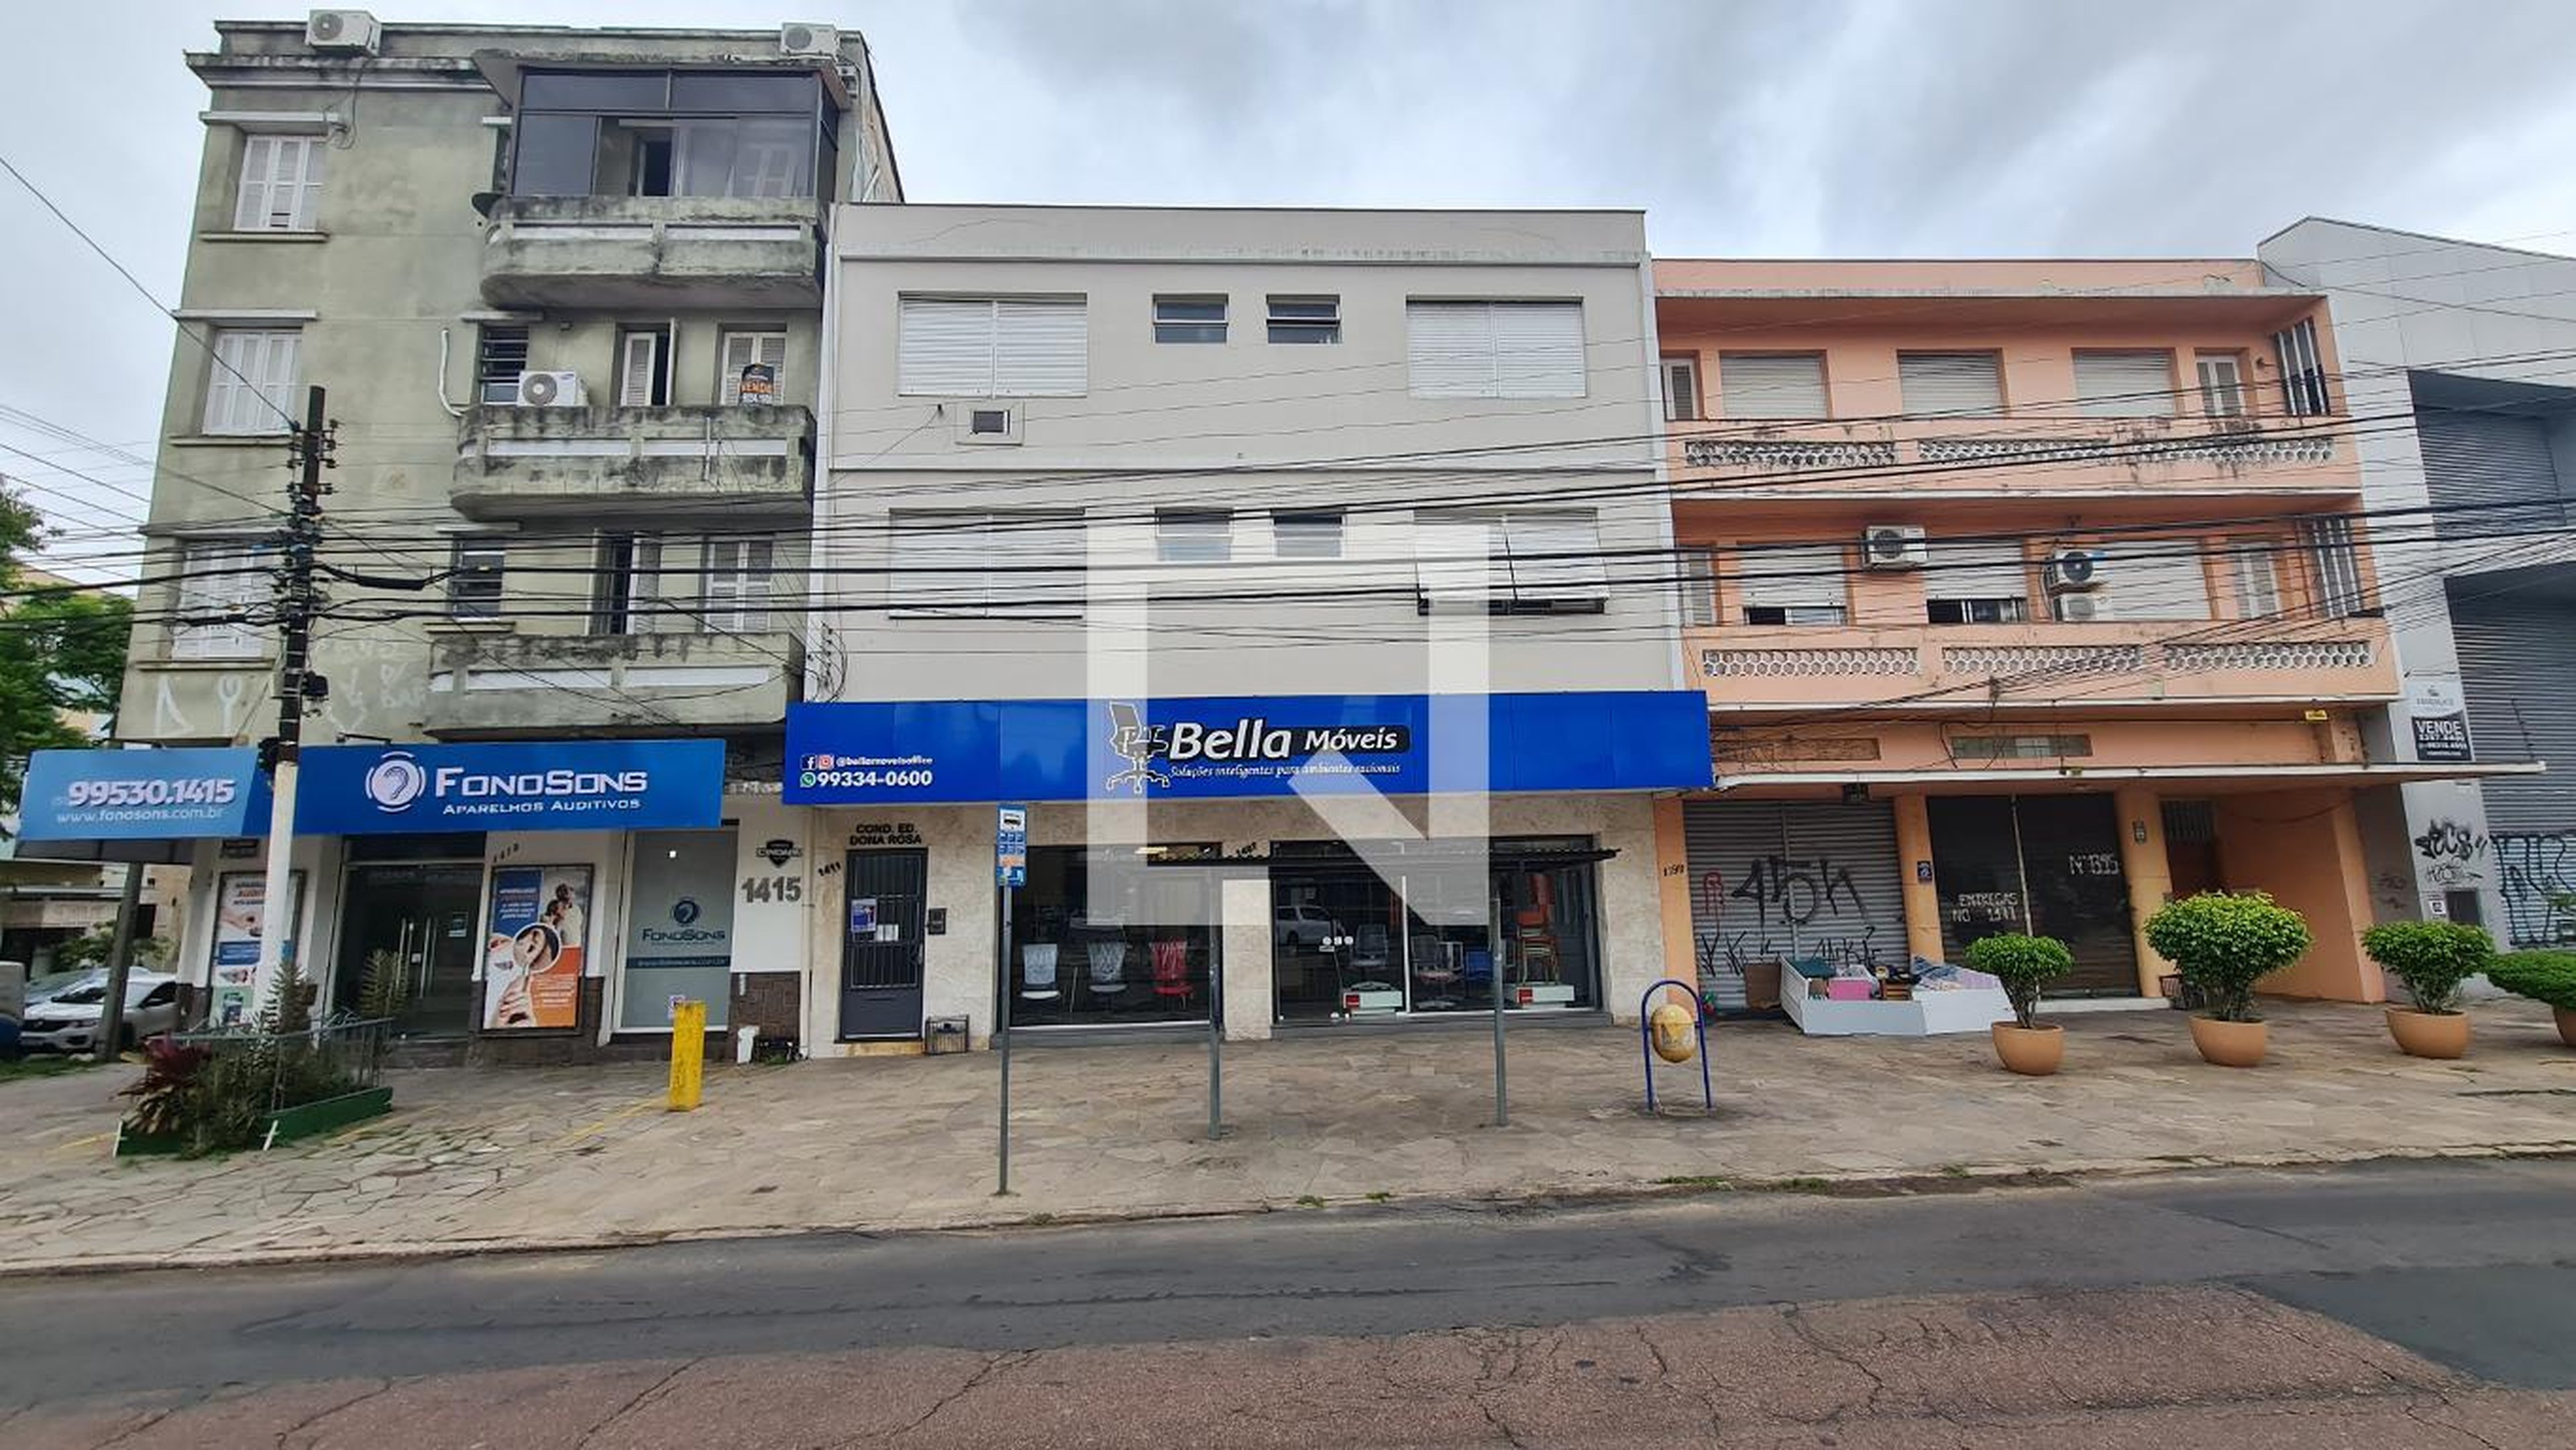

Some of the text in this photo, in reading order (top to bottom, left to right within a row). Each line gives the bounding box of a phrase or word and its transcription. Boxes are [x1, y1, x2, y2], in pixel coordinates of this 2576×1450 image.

[2415, 721, 2462, 735] VENDE
[1169, 718, 1397, 760] Bella Móveis
[817, 770, 932, 786] 99334-0600
[68, 779, 236, 807] 99530.1415
[898, 822, 918, 833] ED.
[849, 833, 922, 845] DONA ROSA
[741, 876, 801, 903] 1415
